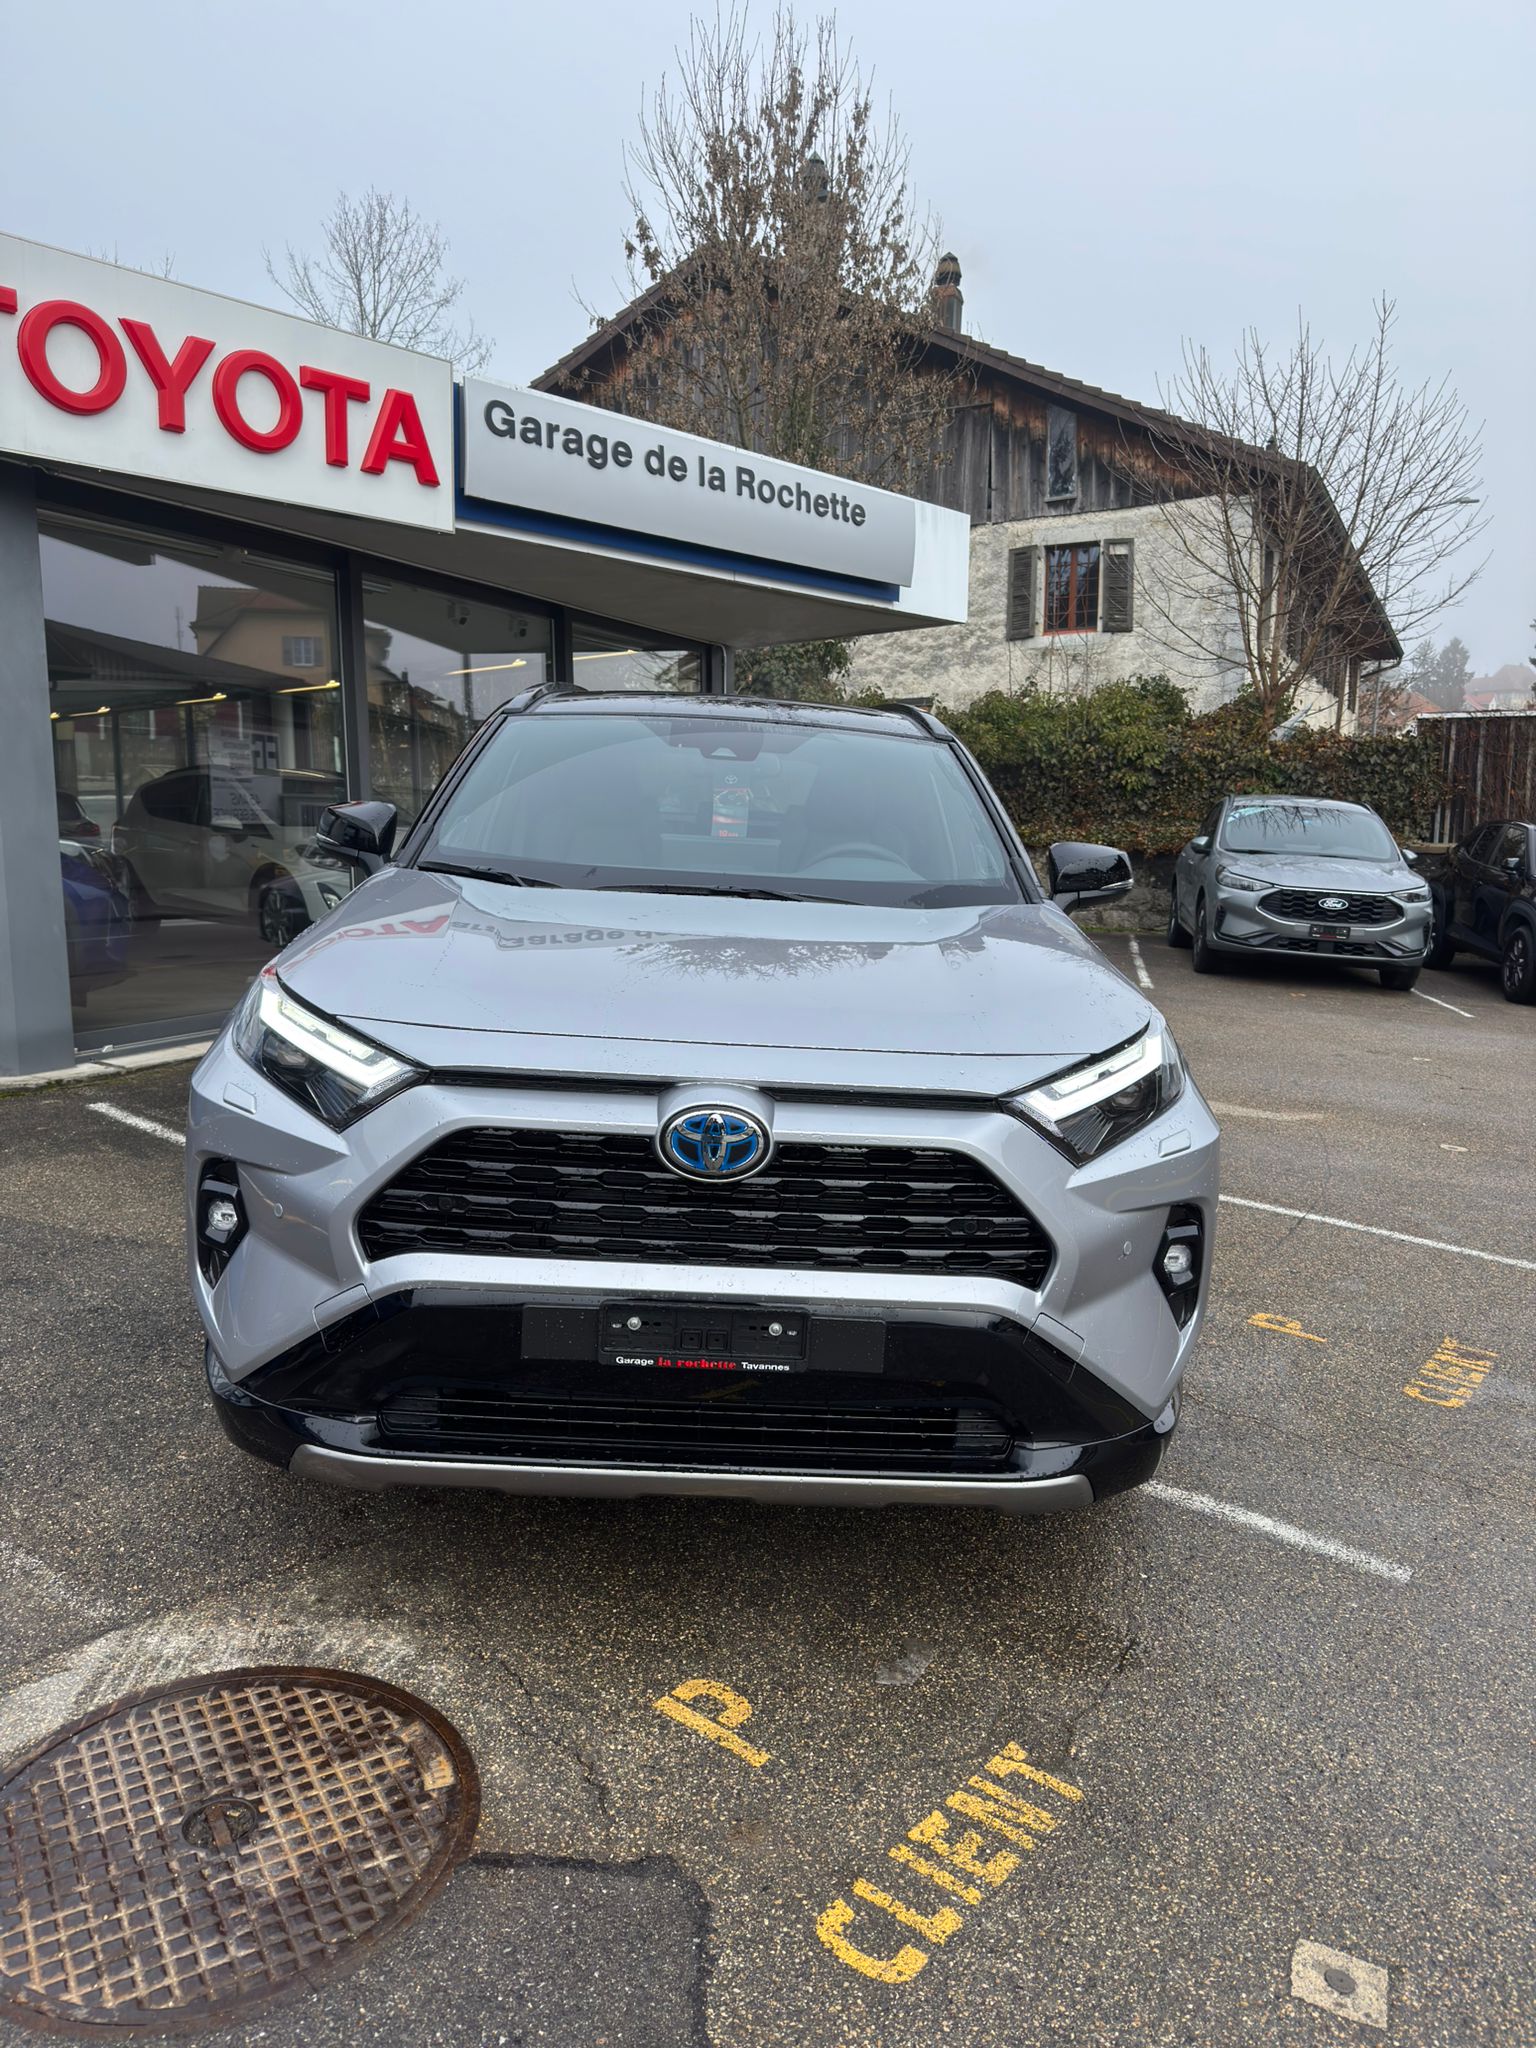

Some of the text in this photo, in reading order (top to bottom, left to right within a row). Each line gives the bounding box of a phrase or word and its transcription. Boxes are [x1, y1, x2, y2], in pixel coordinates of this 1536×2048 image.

[484, 399, 866, 527] Garage de la Rochette
[615, 1356, 790, 1371] Garage la rochette Tavannes
[1246, 1311, 1328, 1343] P
[1402, 1335, 1498, 1409] CLIENT
[652, 1679, 773, 1768] P
[815, 1740, 1085, 1984] CLIENT
